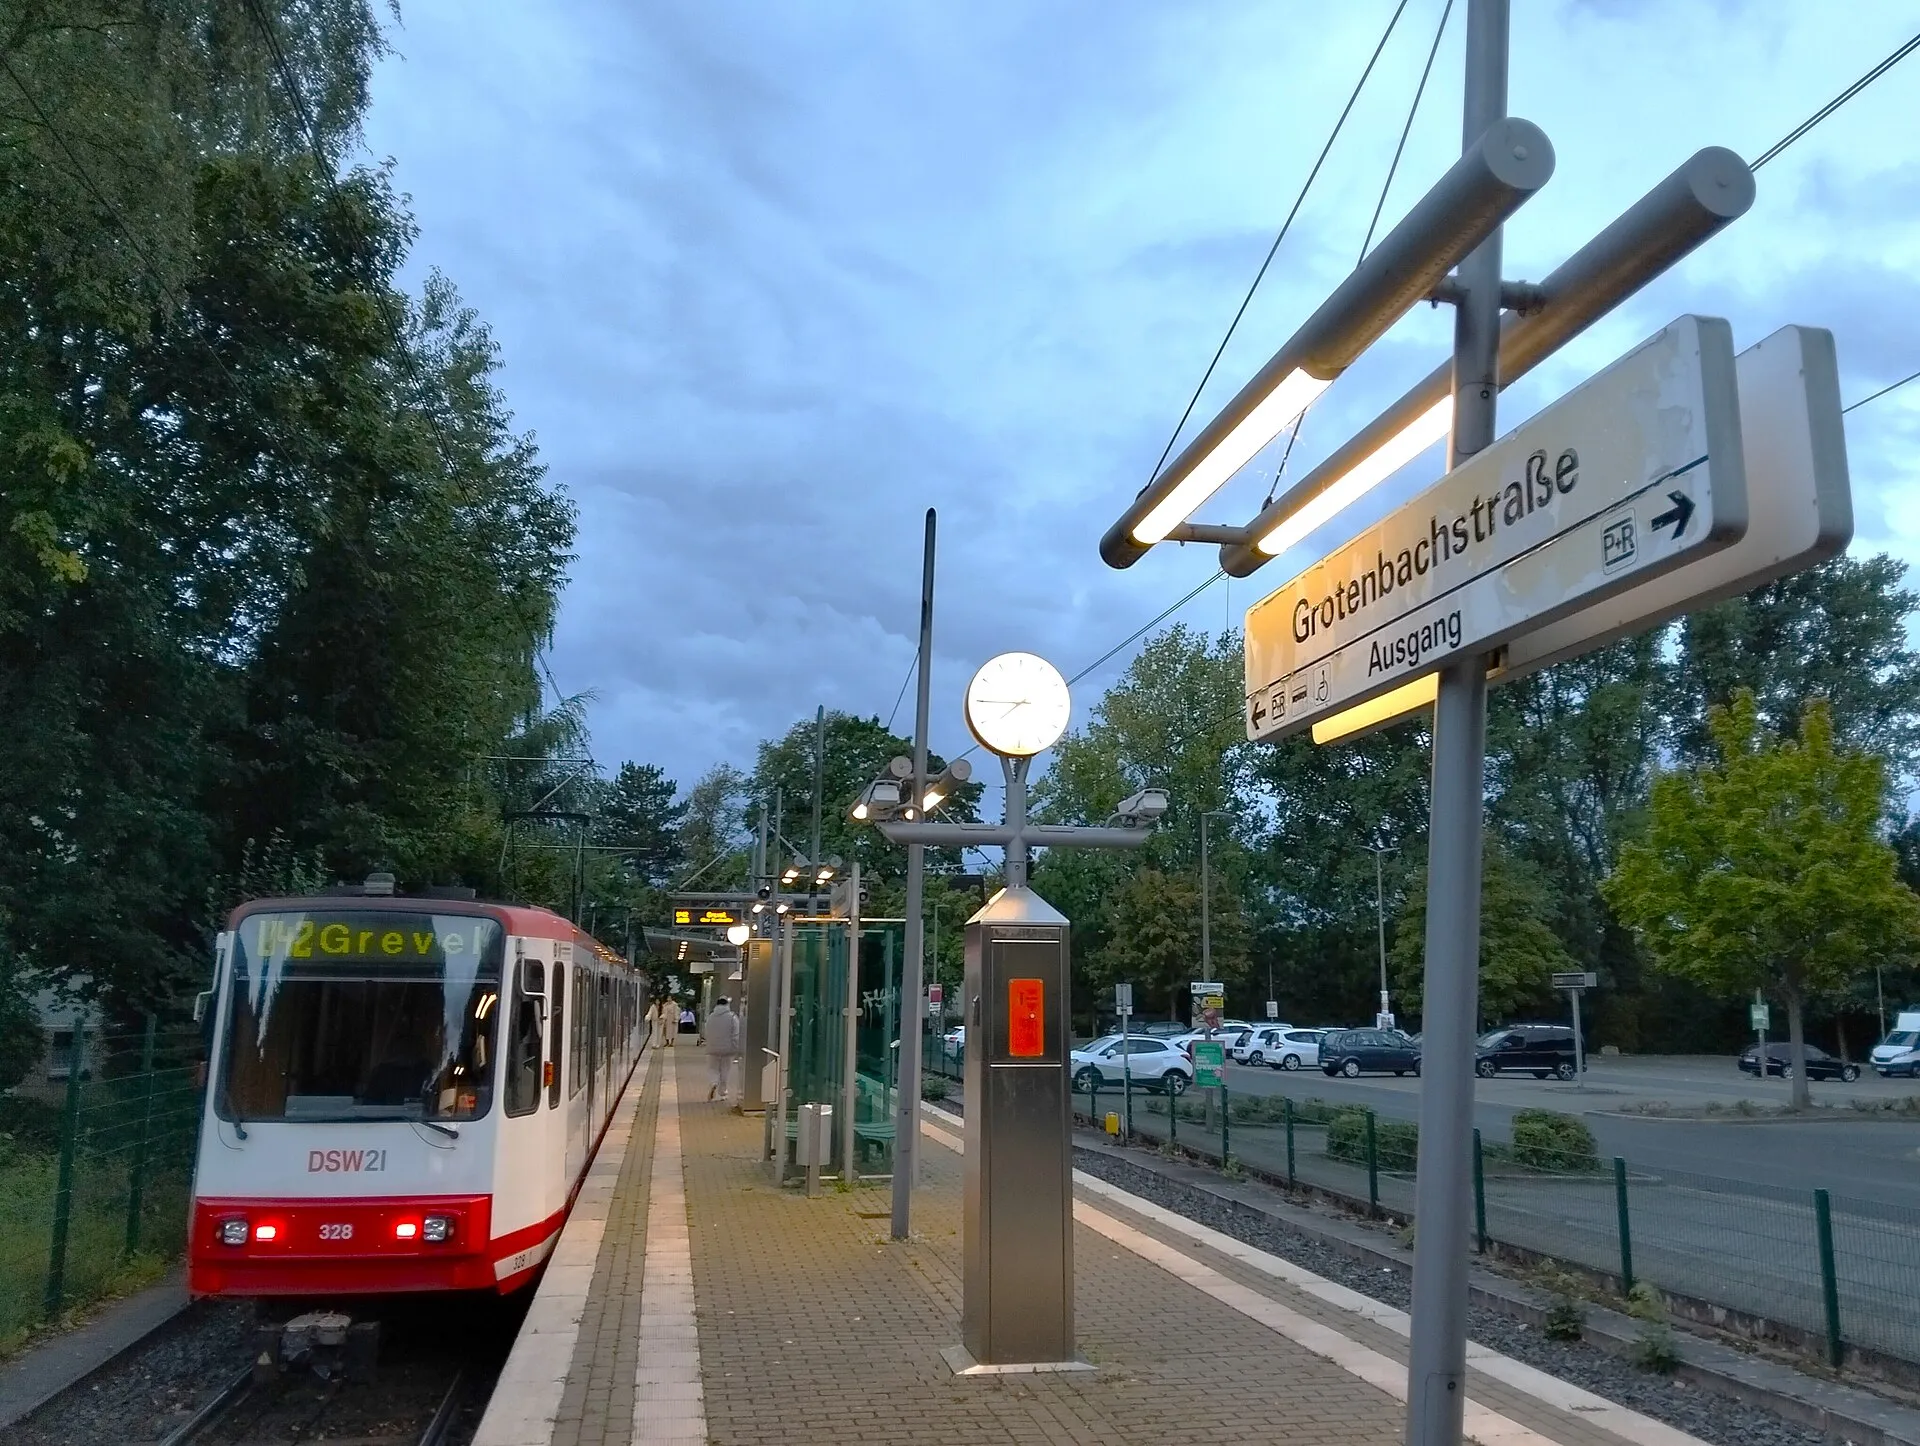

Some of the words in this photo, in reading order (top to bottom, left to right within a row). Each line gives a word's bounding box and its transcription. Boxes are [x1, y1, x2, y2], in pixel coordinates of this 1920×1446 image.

[1292, 448, 1578, 644] Grotenbachstraße
[1603, 523, 1635, 561] P+R
[1367, 609, 1462, 678] Ausgang
[319, 924, 481, 955] Grevel
[307, 1150, 386, 1172] DSW21
[319, 1224, 353, 1240] 328
